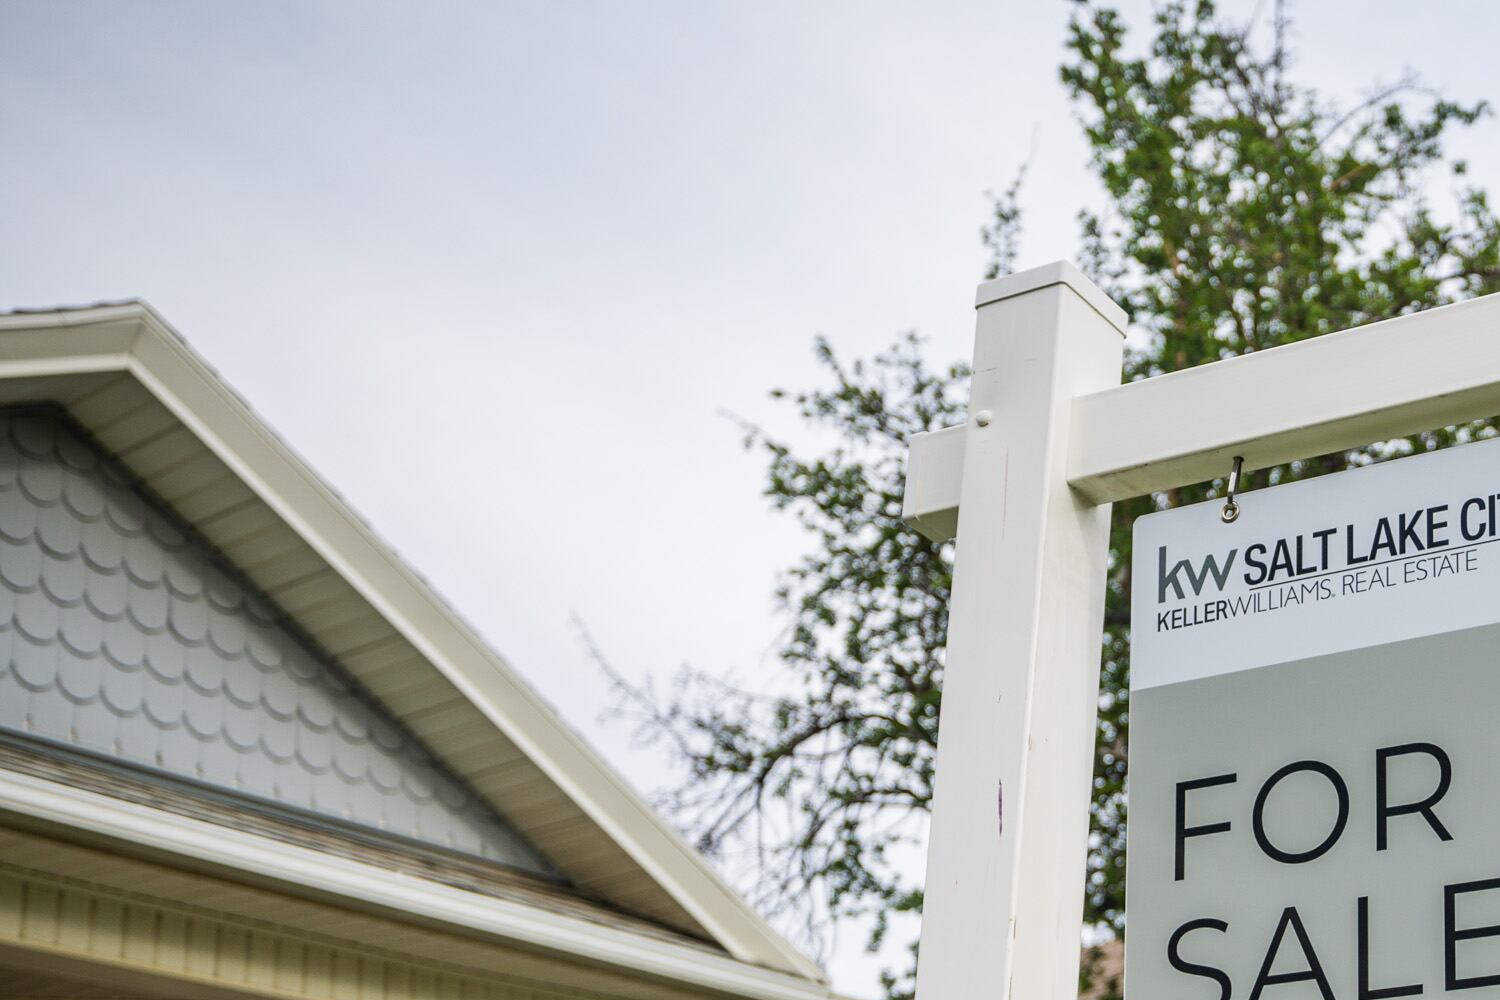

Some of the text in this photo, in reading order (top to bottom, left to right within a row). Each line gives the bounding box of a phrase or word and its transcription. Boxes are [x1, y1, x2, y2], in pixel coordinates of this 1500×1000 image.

[1158, 546, 1238, 604] kw
[1244, 528, 1337, 586] SALT
[1347, 505, 1450, 565] LAKE
[1342, 566, 1396, 596] REAL
[1404, 549, 1478, 583] ESTATE
[1175, 742, 1454, 881] FOR
